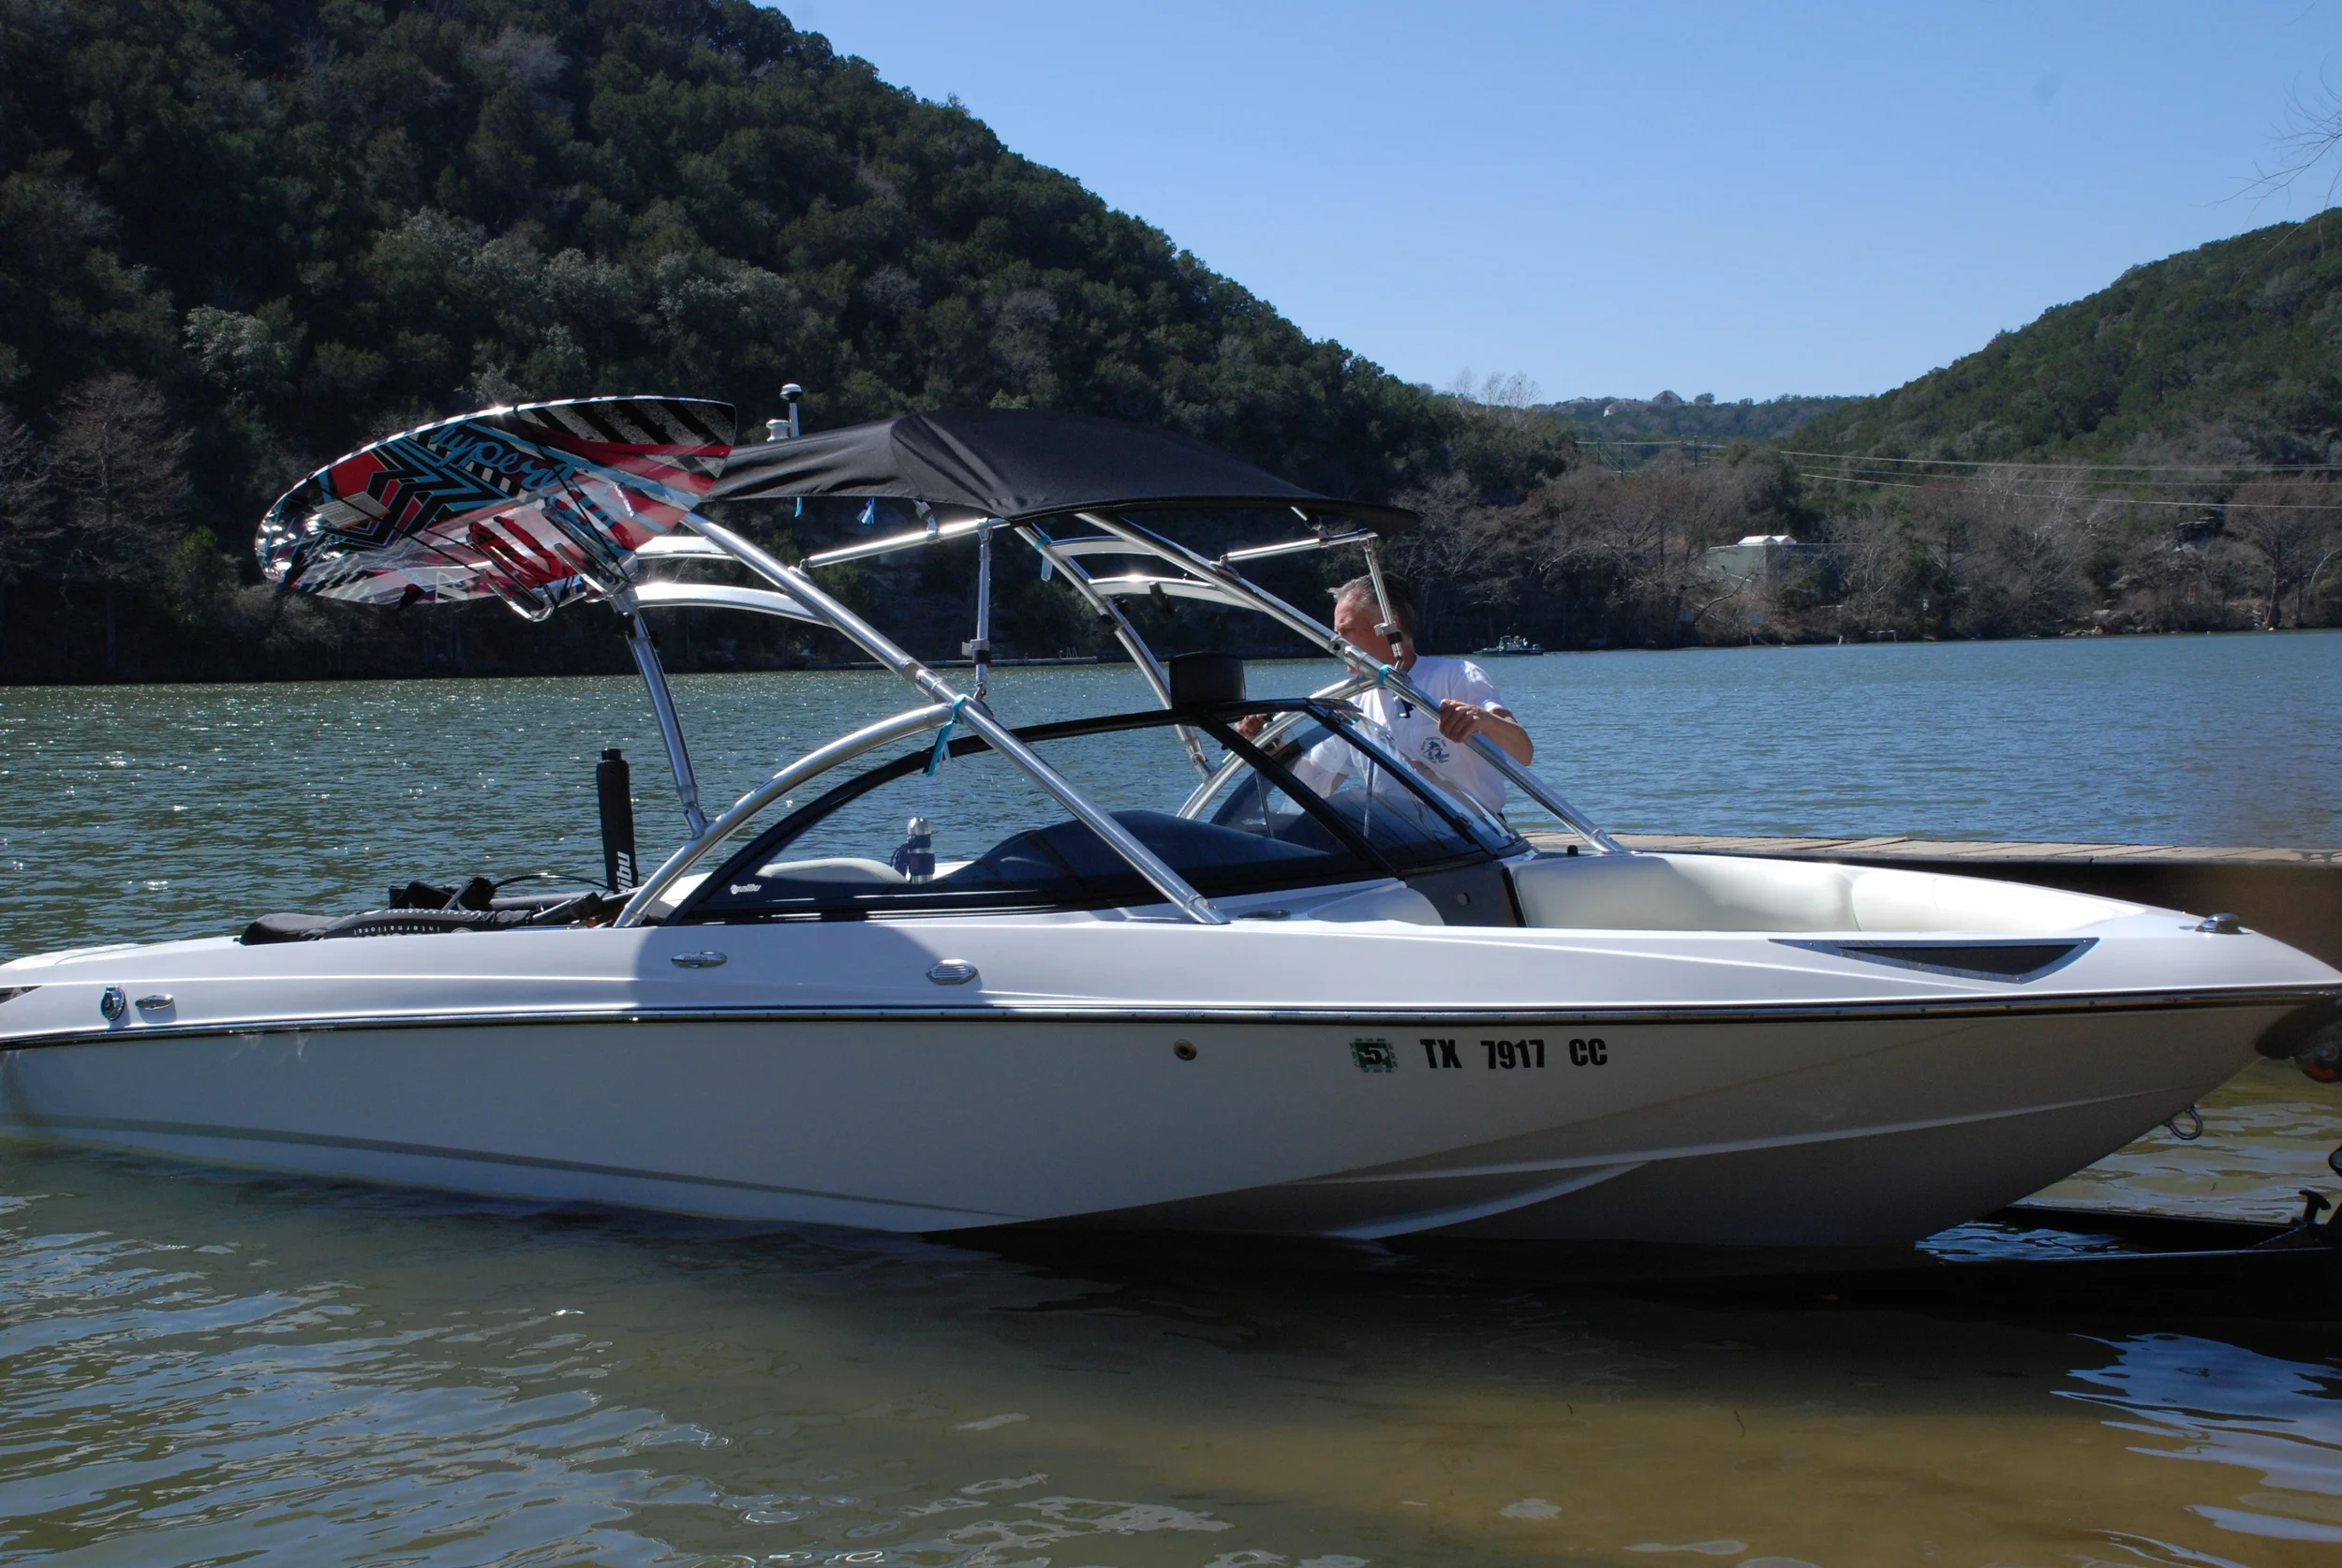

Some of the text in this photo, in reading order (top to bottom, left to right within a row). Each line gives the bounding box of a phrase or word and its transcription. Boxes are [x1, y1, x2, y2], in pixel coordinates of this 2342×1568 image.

[353, 925, 441, 936] international
[1419, 1038, 1462, 1070] TX
[1480, 1039, 1545, 1070] 7917
[1568, 1038, 1608, 1067] CC
